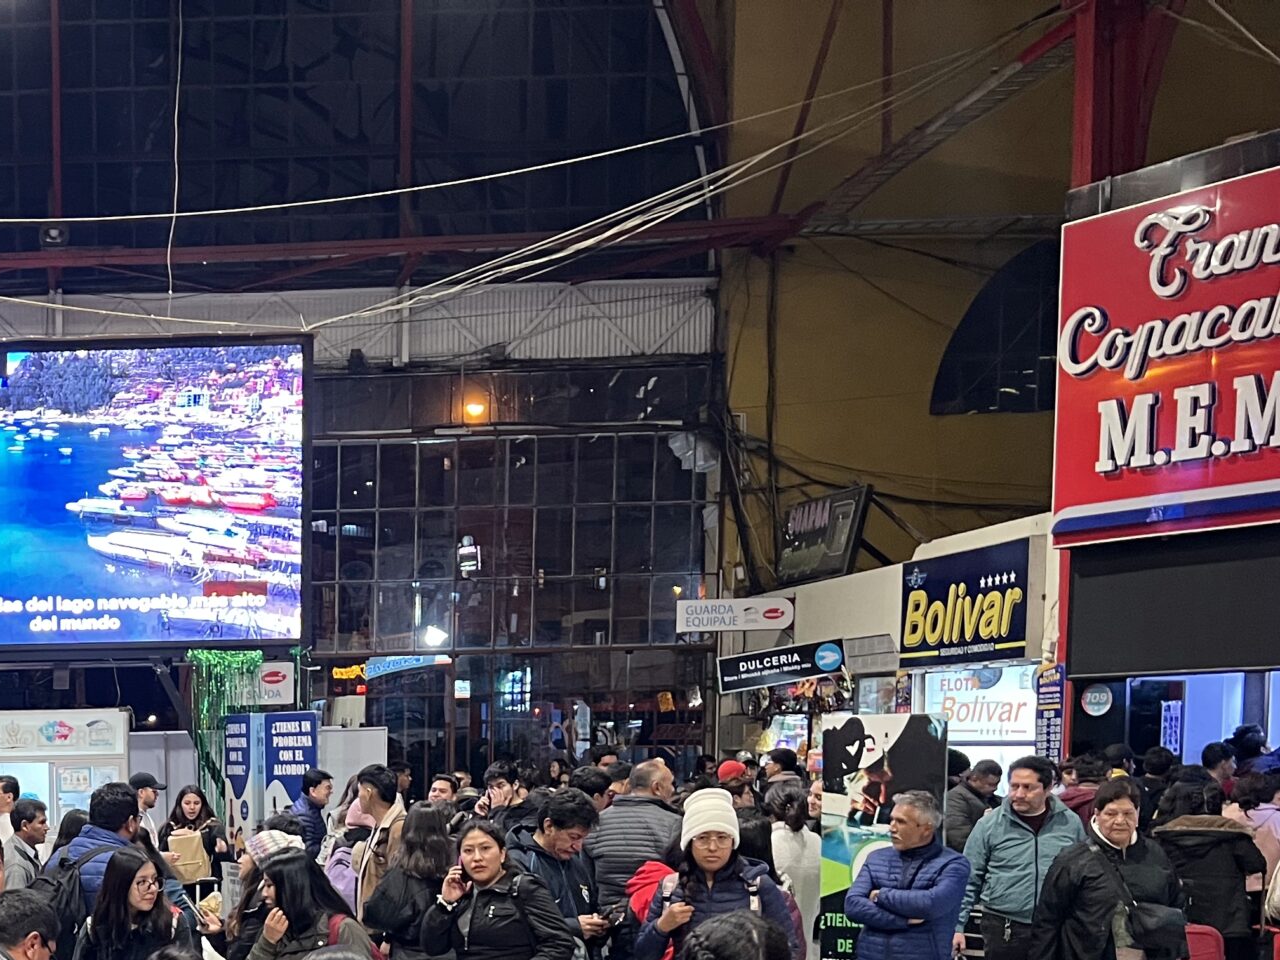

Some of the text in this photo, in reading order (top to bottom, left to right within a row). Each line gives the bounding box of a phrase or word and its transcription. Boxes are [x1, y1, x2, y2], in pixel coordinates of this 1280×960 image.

[25, 595, 54, 612] del
[56, 595, 94, 614] lago
[97, 592, 188, 613] navegable
[231, 592, 267, 608] alto
[685, 604, 735, 616] GUARDA
[685, 615, 739, 628] EQUIPAJE
[903, 582, 1024, 648] Bolivar
[29, 614, 121, 632] del mundo
[739, 652, 801, 672] DULCERIA
[1086, 692, 1108, 704] 109
[942, 696, 1028, 723] Bolivar
[271, 721, 311, 735] ¿TIENES UN
[272, 736, 312, 748] PROBLEMA
[279, 750, 304, 762] CON EL
[819, 912, 865, 930] ¿TIEN
[837, 938, 854, 953] DE
